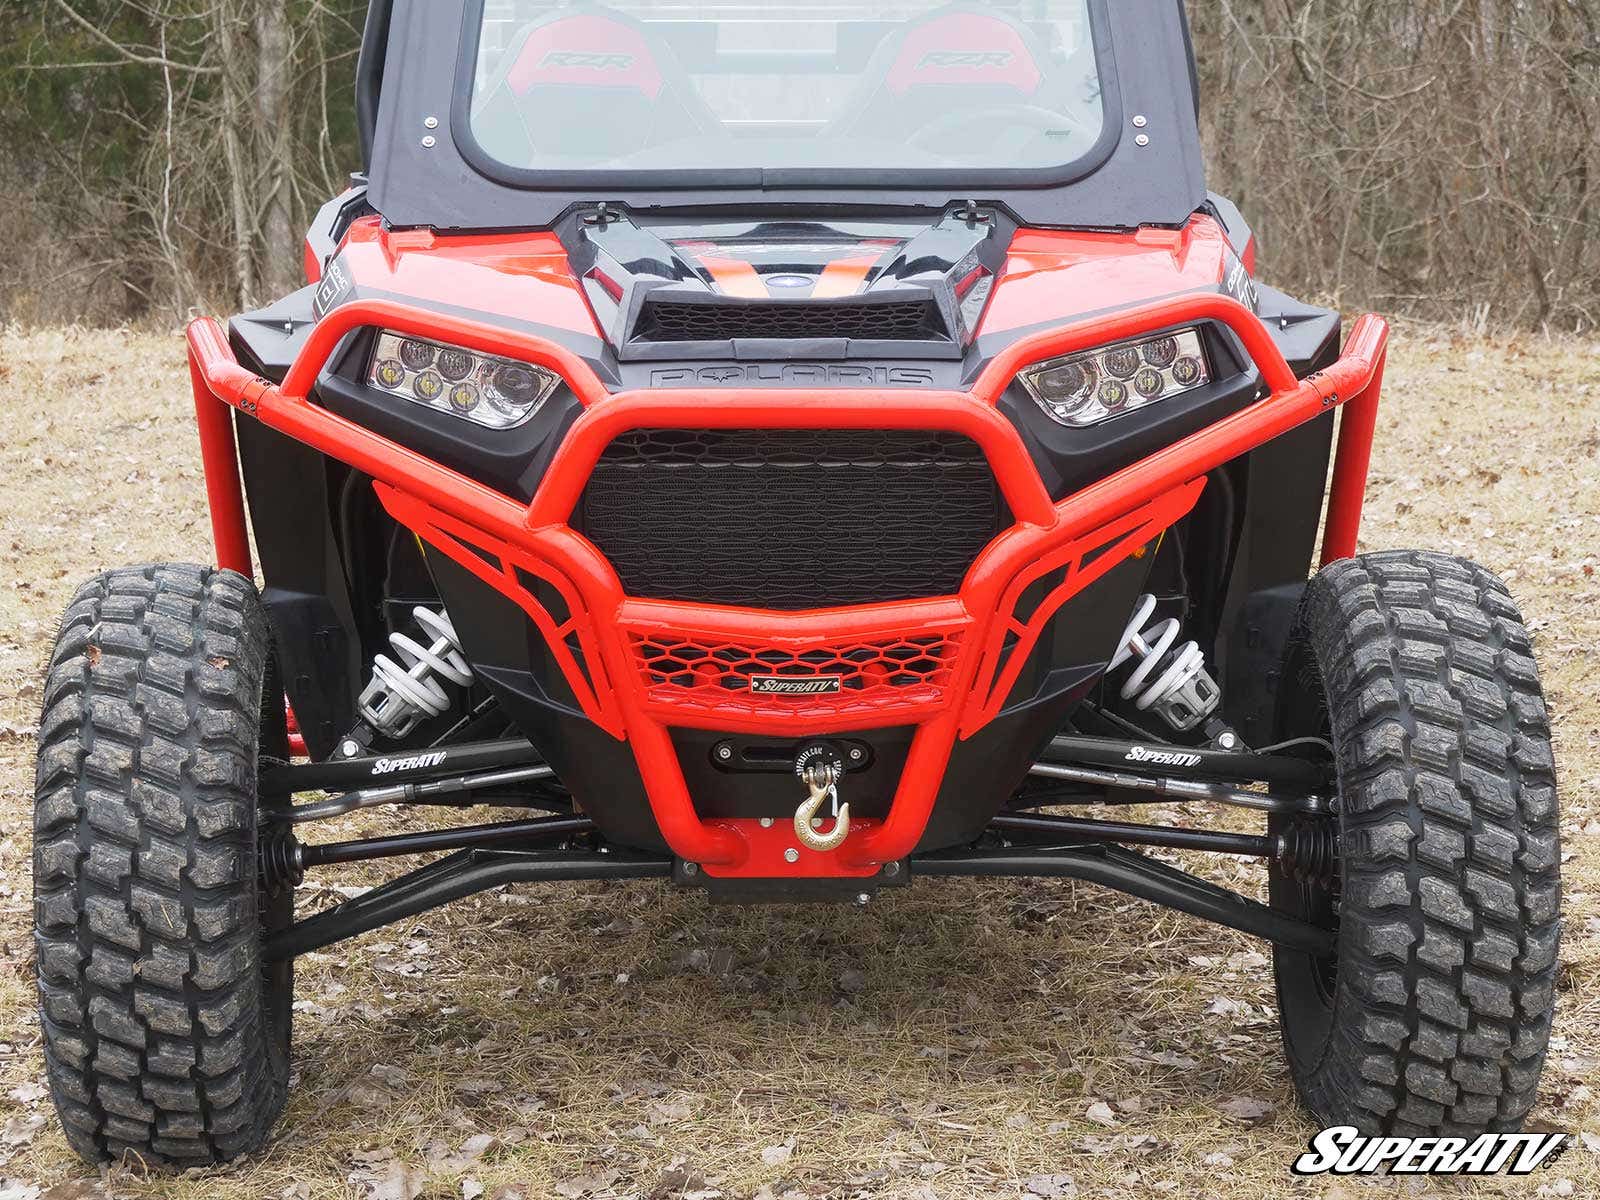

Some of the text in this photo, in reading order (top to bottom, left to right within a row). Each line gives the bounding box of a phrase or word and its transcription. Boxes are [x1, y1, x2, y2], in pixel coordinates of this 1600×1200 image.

[538, 51, 635, 71] RZR
[913, 51, 1012, 70] RZR
[650, 365, 934, 387] POLARIS
[759, 680, 832, 692] SUPERATV
[371, 751, 446, 775] SUPERATV
[1125, 746, 1201, 767] SUPERATV
